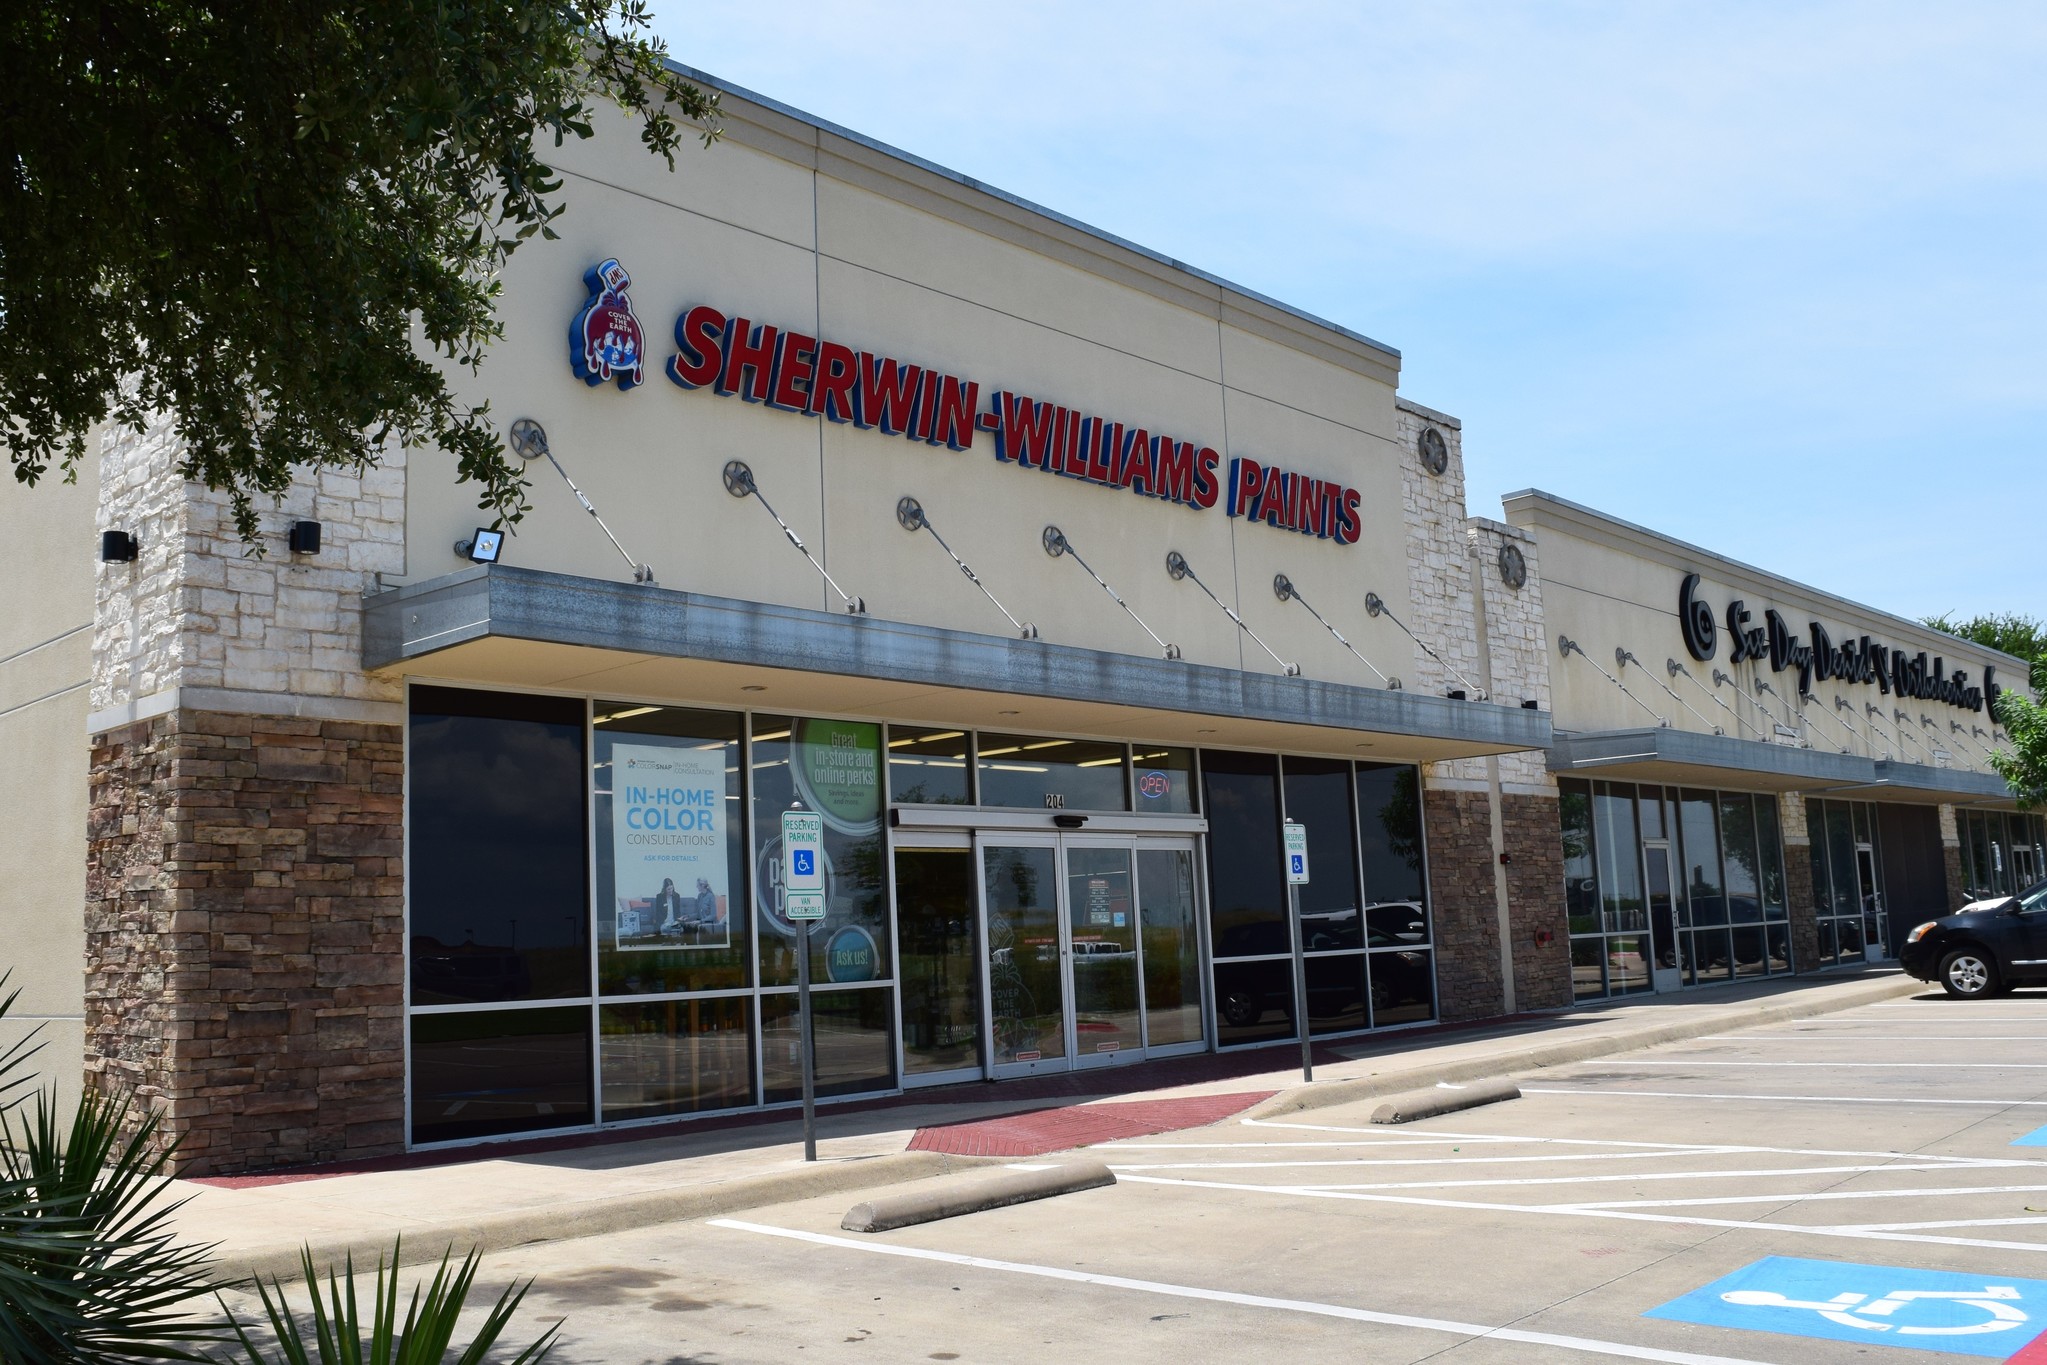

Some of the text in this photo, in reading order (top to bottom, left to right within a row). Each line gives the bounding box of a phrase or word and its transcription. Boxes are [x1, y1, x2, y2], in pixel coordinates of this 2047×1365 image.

[608, 311, 631, 322] COVER
[613, 318, 628, 327] THE
[609, 322, 632, 334] EARTH
[667, 305, 1361, 545] SHERWIN-WILLIAMS PAINTS
[1726, 600, 1770, 663] Six
[1765, 609, 1814, 694] Day
[1809, 622, 1876, 684] Dental
[831, 732, 857, 749] Great
[816, 748, 874, 767] in-store and
[814, 767, 876, 787] online perks!
[1140, 776, 1169, 793] OPEN
[626, 786, 715, 806] IN-HOME
[1046, 794, 1064, 809] 204
[626, 807, 714, 831] COLOR
[785, 820, 820, 830] RESERVED
[626, 834, 715, 846] CONSULTATIONS
[789, 832, 817, 842] PARKING
[1285, 833, 1305, 841] RESERVED
[1288, 842, 1304, 850] PARKING
[791, 906, 822, 914] ACCESSIBLE
[854, 948, 868, 965] us!
[998, 999, 1015, 1009] THE
